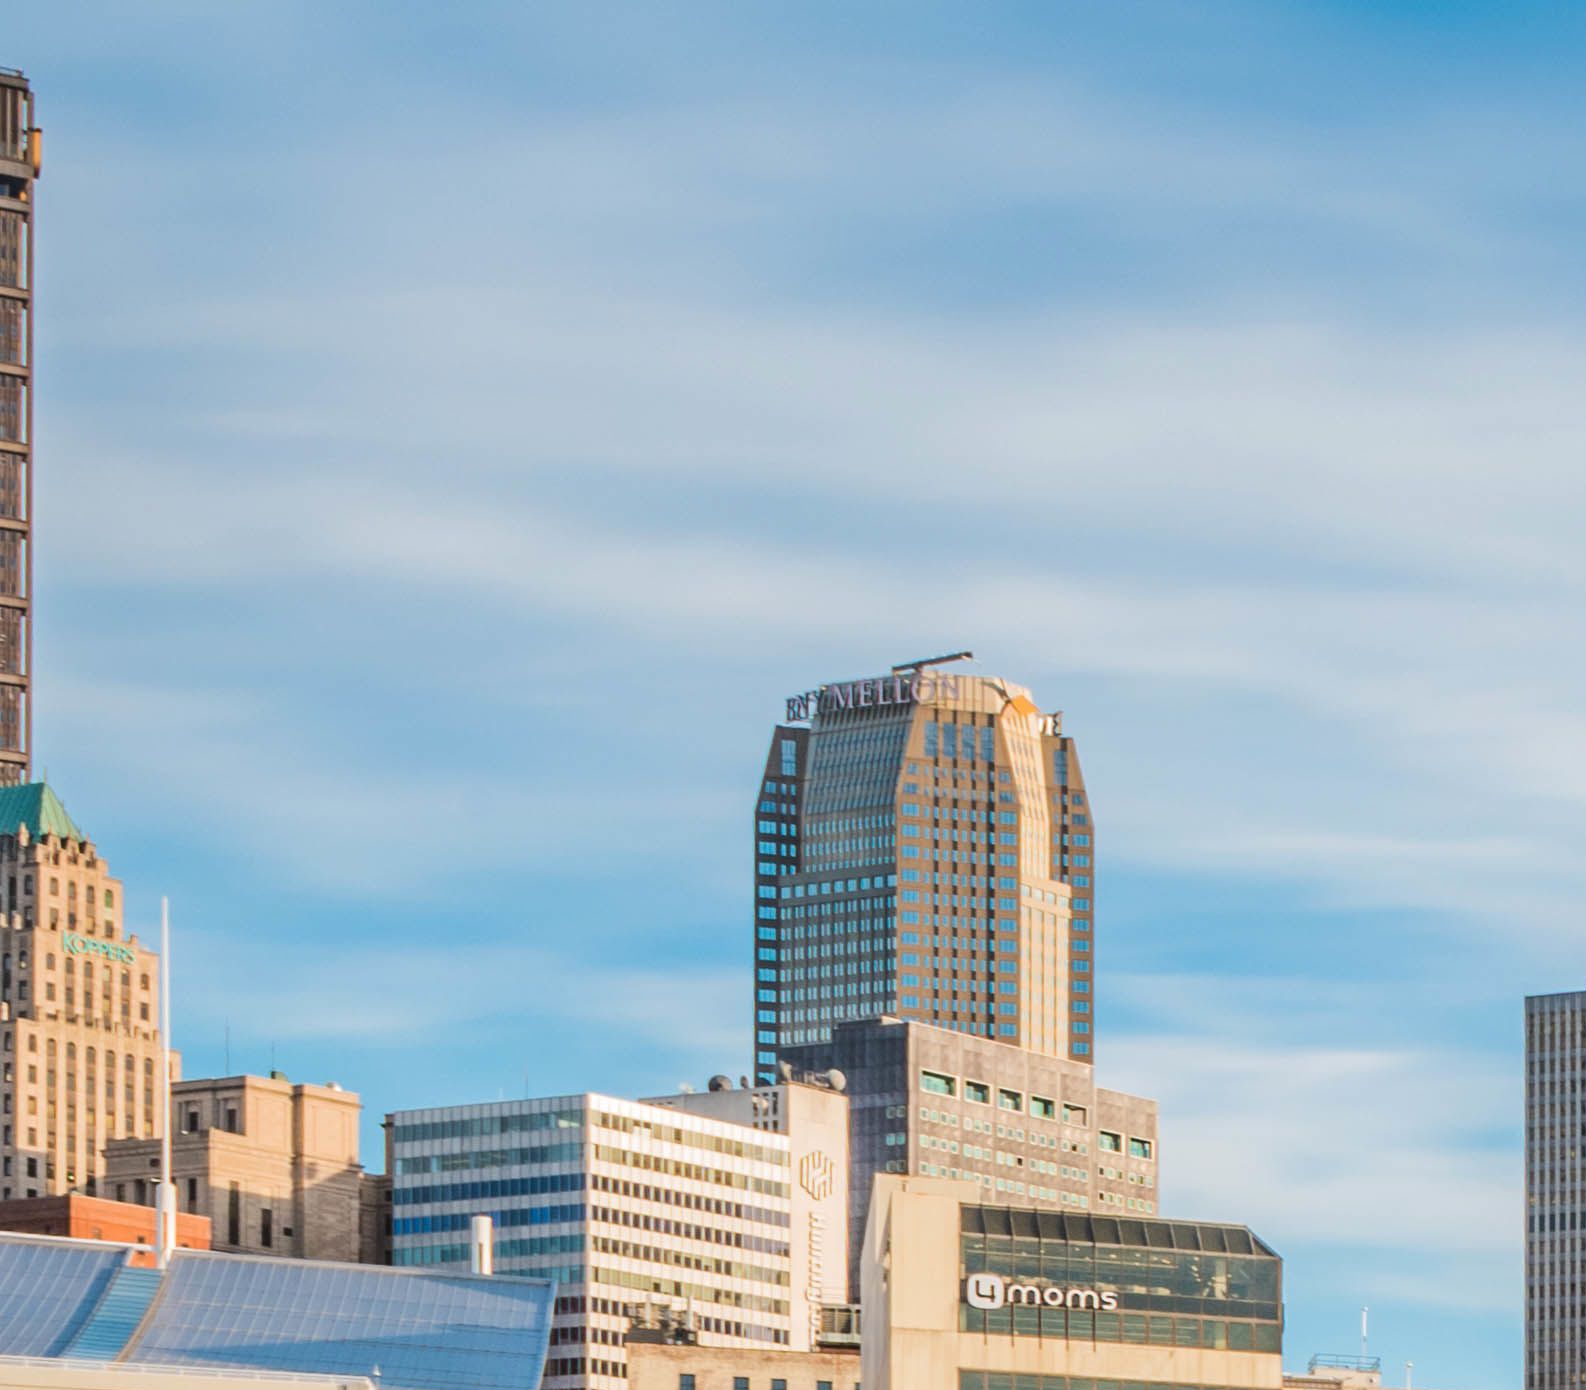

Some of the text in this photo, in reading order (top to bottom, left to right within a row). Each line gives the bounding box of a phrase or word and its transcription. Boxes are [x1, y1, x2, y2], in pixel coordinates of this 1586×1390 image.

[829, 672, 960, 711] MELLON
[63, 930, 136, 965] KOPPERS
[967, 1273, 1119, 1310] 4moms
